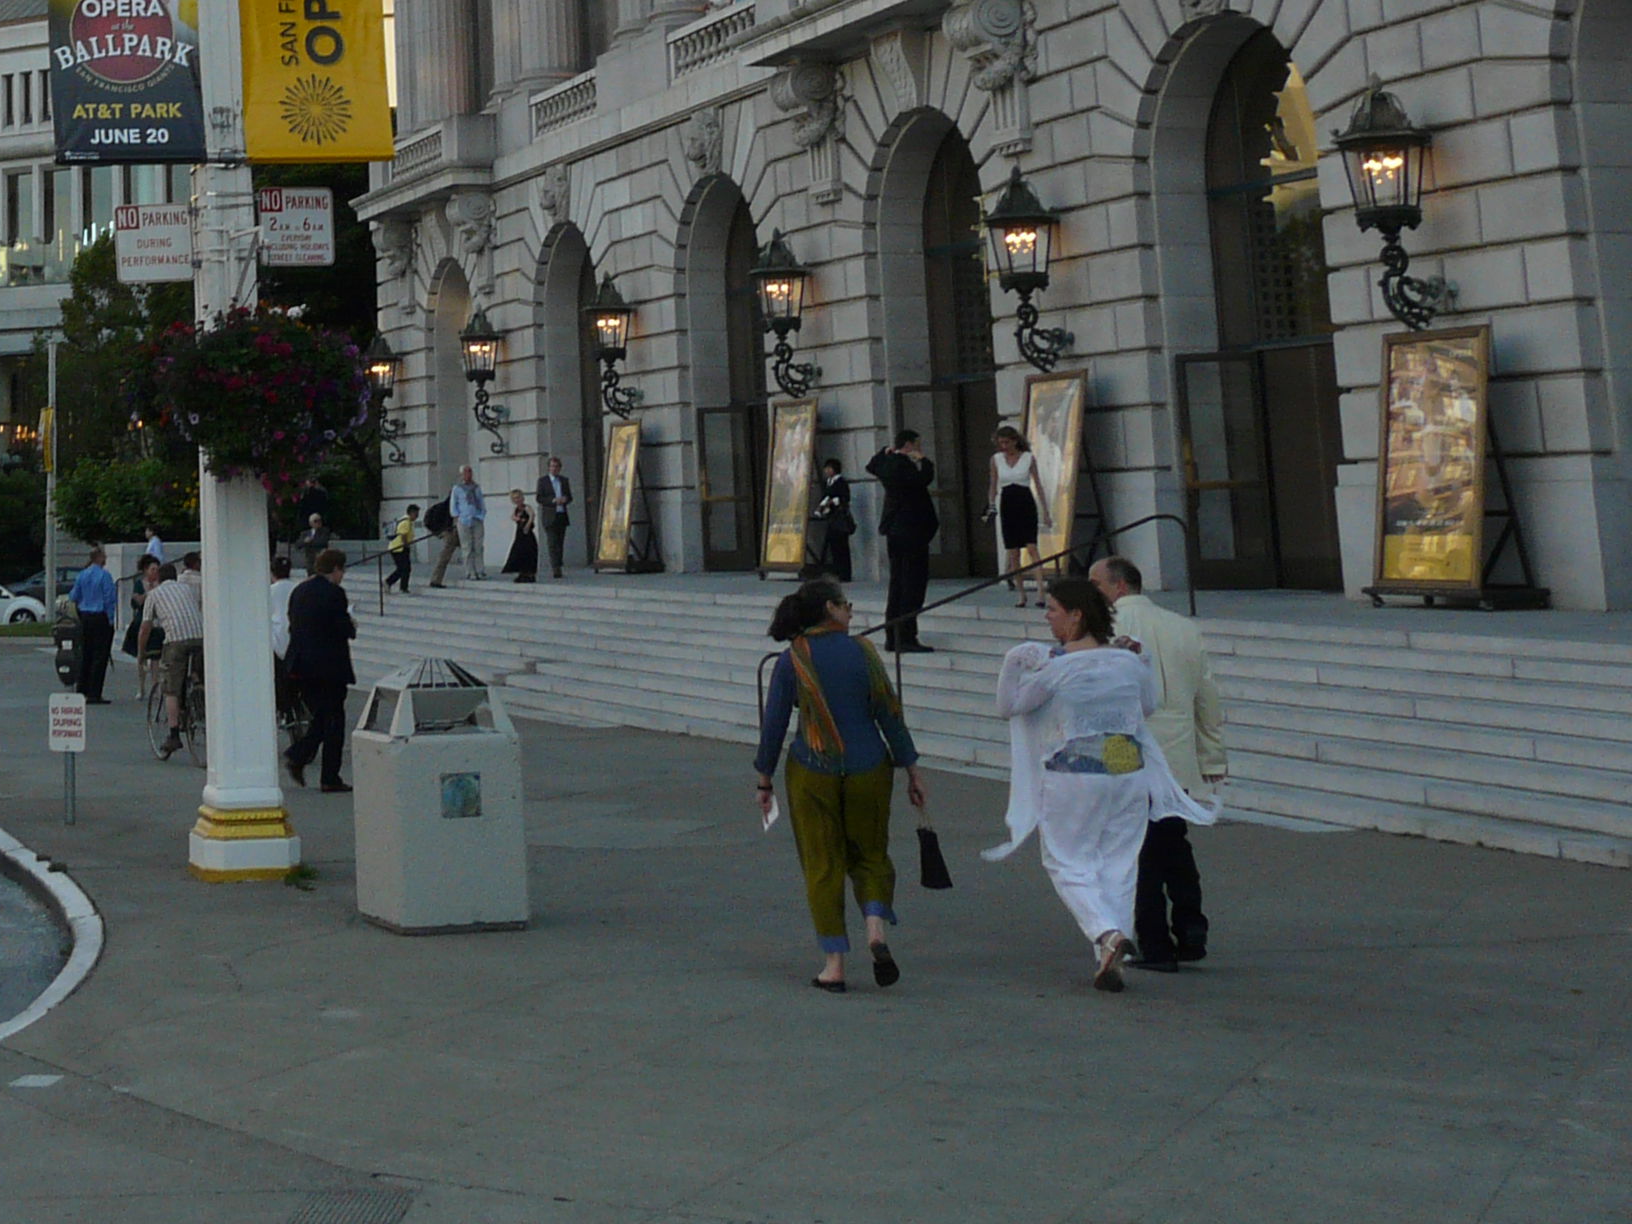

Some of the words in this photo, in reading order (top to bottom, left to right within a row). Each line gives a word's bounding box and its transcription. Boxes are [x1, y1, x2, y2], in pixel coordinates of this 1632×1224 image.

[54, 33, 195, 70] BALLPARK
[281, 22, 299, 66] SAN
[94, 80, 145, 93] FRANCISCO
[72, 103, 124, 119] AT&T
[130, 102, 182, 119] PARK
[89, 129, 141, 145] JUNE
[145, 128, 169, 144] 20
[261, 190, 281, 210] NO
[285, 195, 329, 210] PARKING
[118, 208, 139, 227] NO
[142, 210, 188, 226] PARKING
[269, 217, 277, 230] 2
[303, 217, 311, 230] 6
[137, 238, 172, 249] DURING
[121, 254, 190, 267] PERFORMANCE
